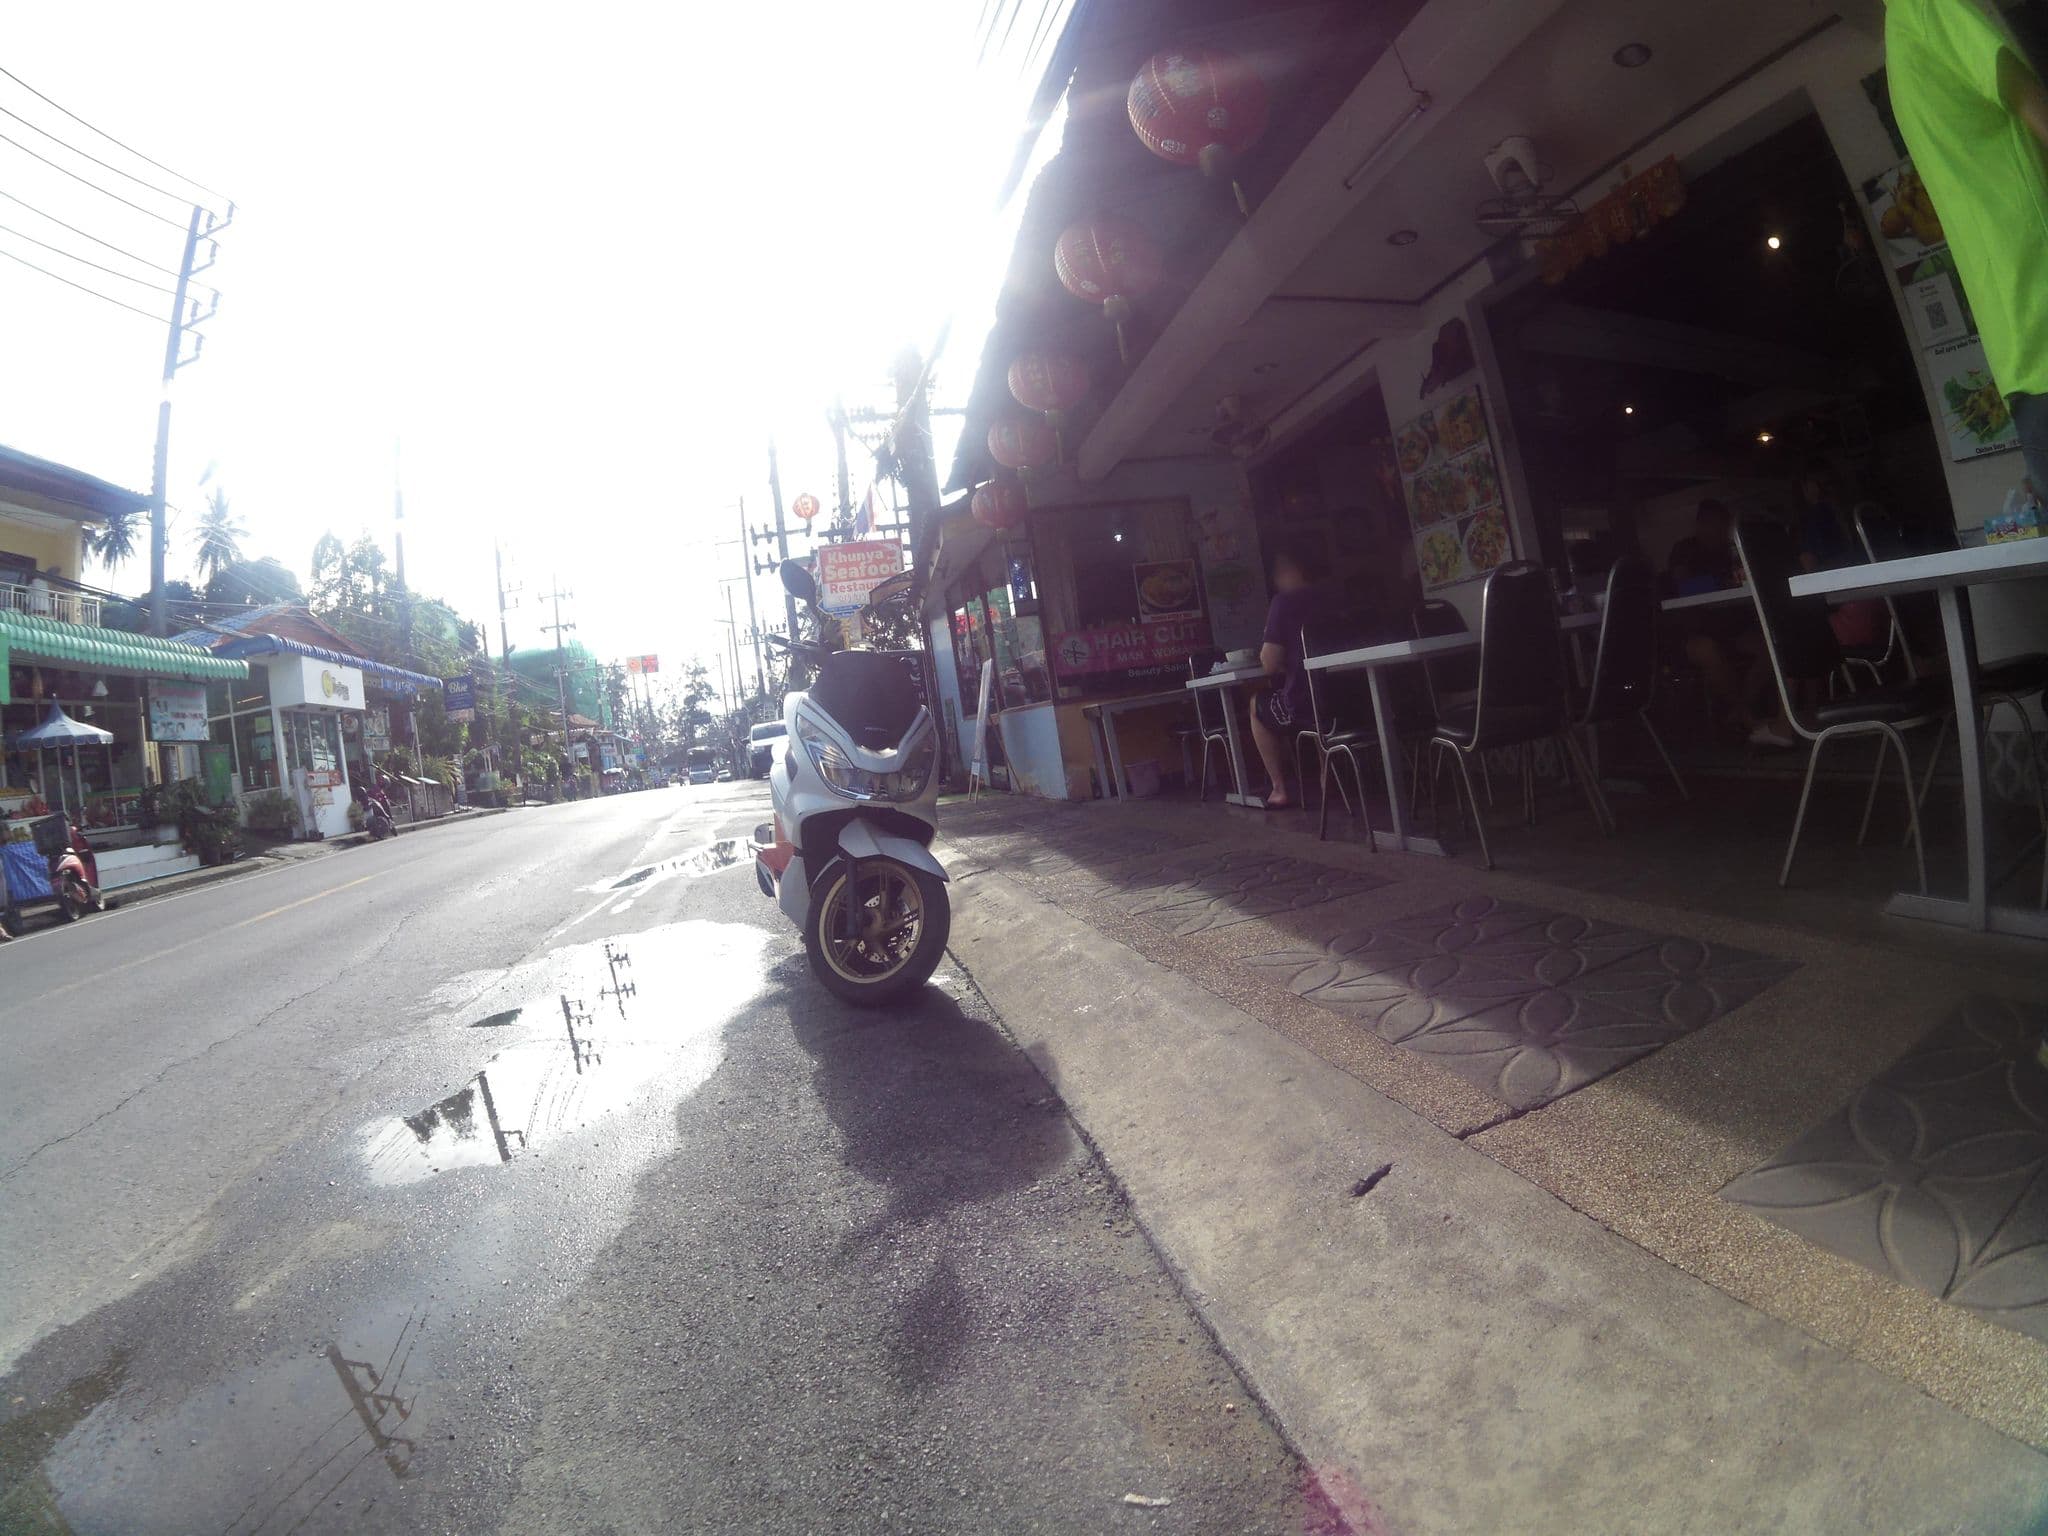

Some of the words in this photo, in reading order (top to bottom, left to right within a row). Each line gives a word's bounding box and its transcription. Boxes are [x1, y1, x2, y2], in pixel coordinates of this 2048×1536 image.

[828, 550, 883, 564] Khunya
[825, 560, 902, 580] Seafood
[1095, 630, 1146, 650] HAIR
[1155, 624, 1199, 643] CUT
[447, 681, 468, 694] Blue
